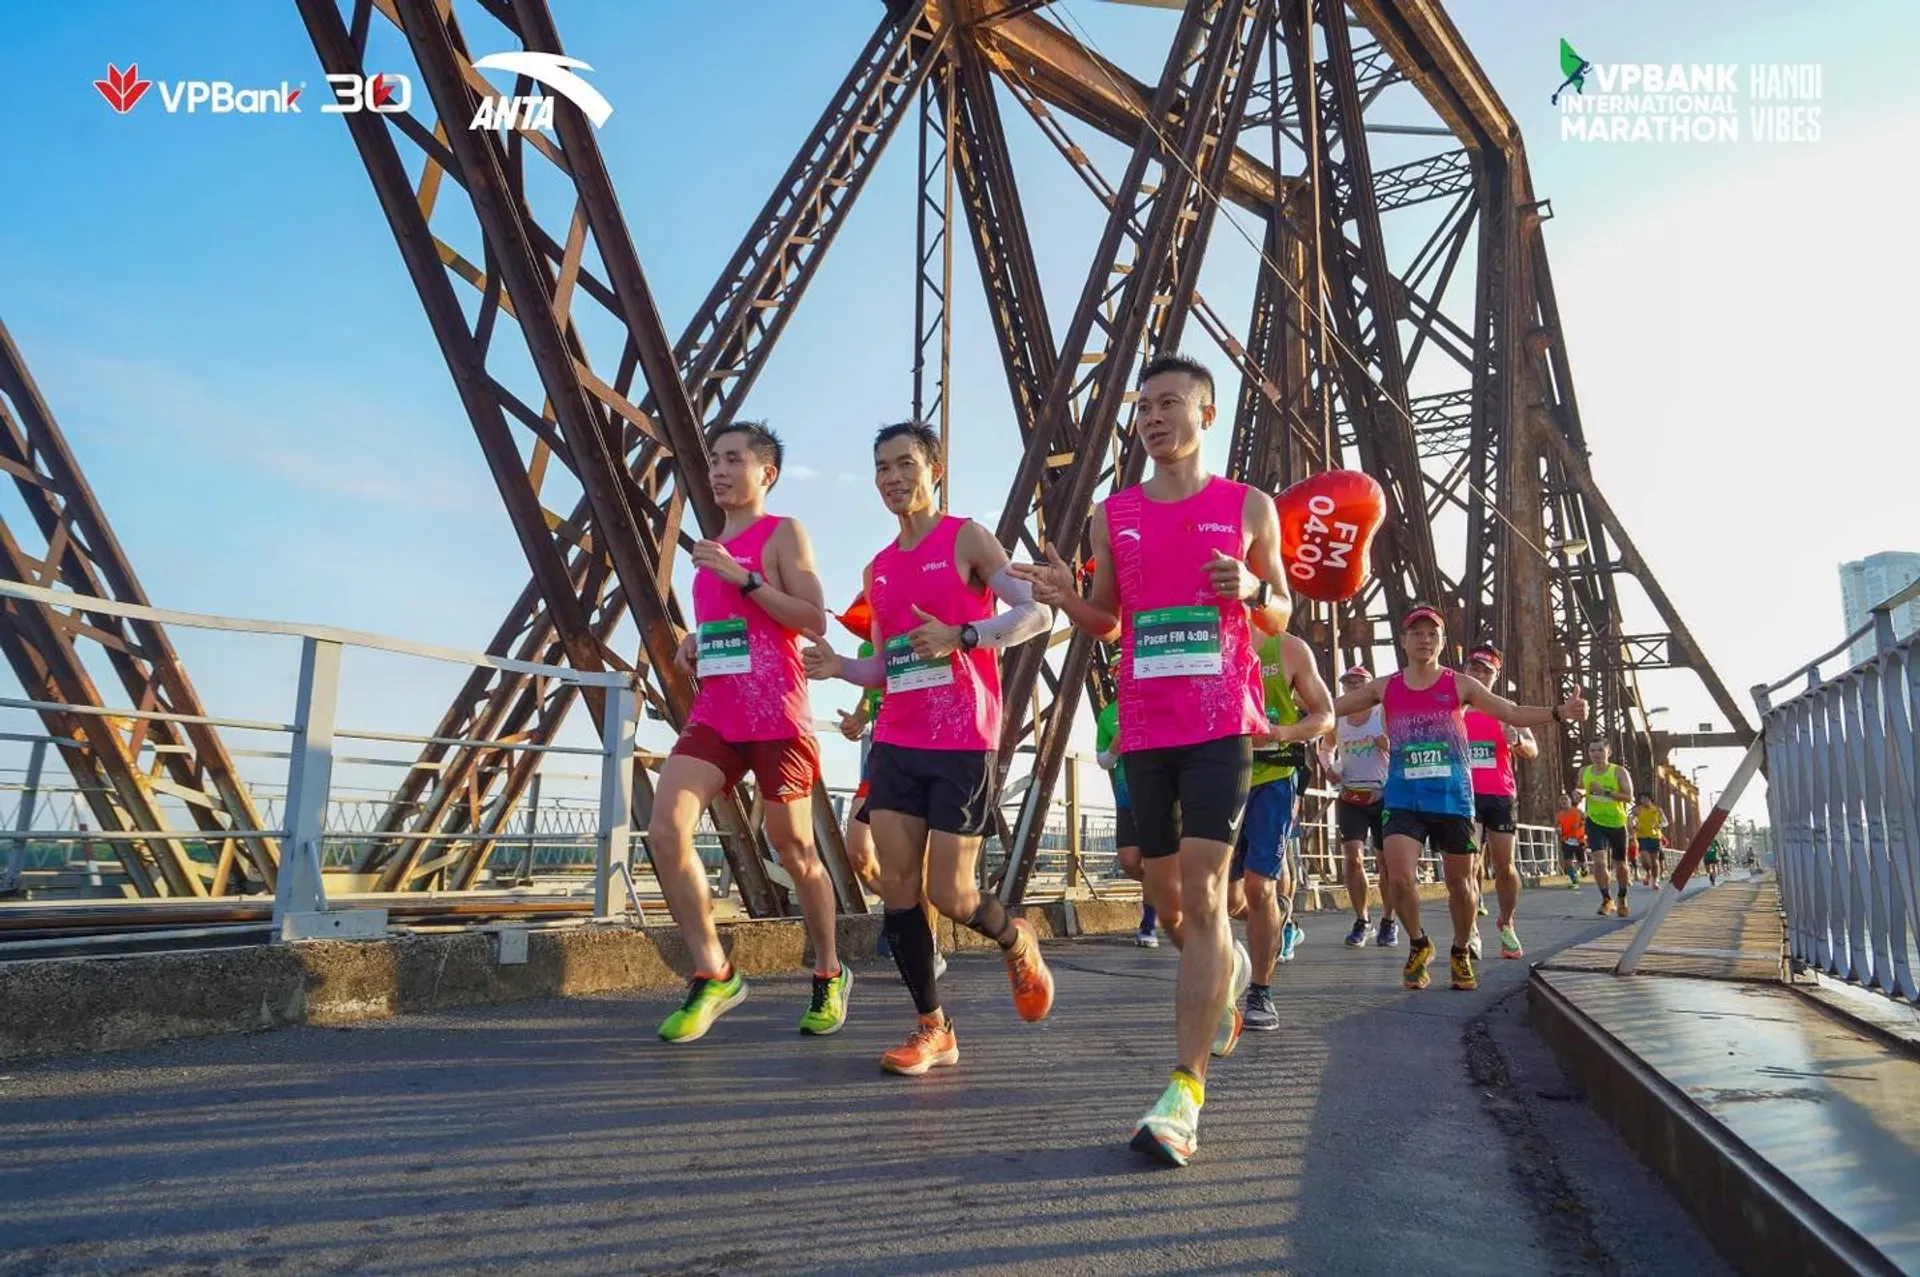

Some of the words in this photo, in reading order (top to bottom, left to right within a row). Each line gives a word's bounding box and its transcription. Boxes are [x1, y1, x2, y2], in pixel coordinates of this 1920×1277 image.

[1289, 495, 1335, 580] 04:00
[1322, 521, 1359, 569] FM
[1143, 633, 1168, 646] Pacer
[1169, 630, 1185, 643] FM
[1186, 630, 1209, 642] 4:00
[1410, 750, 1442, 765] 91271
